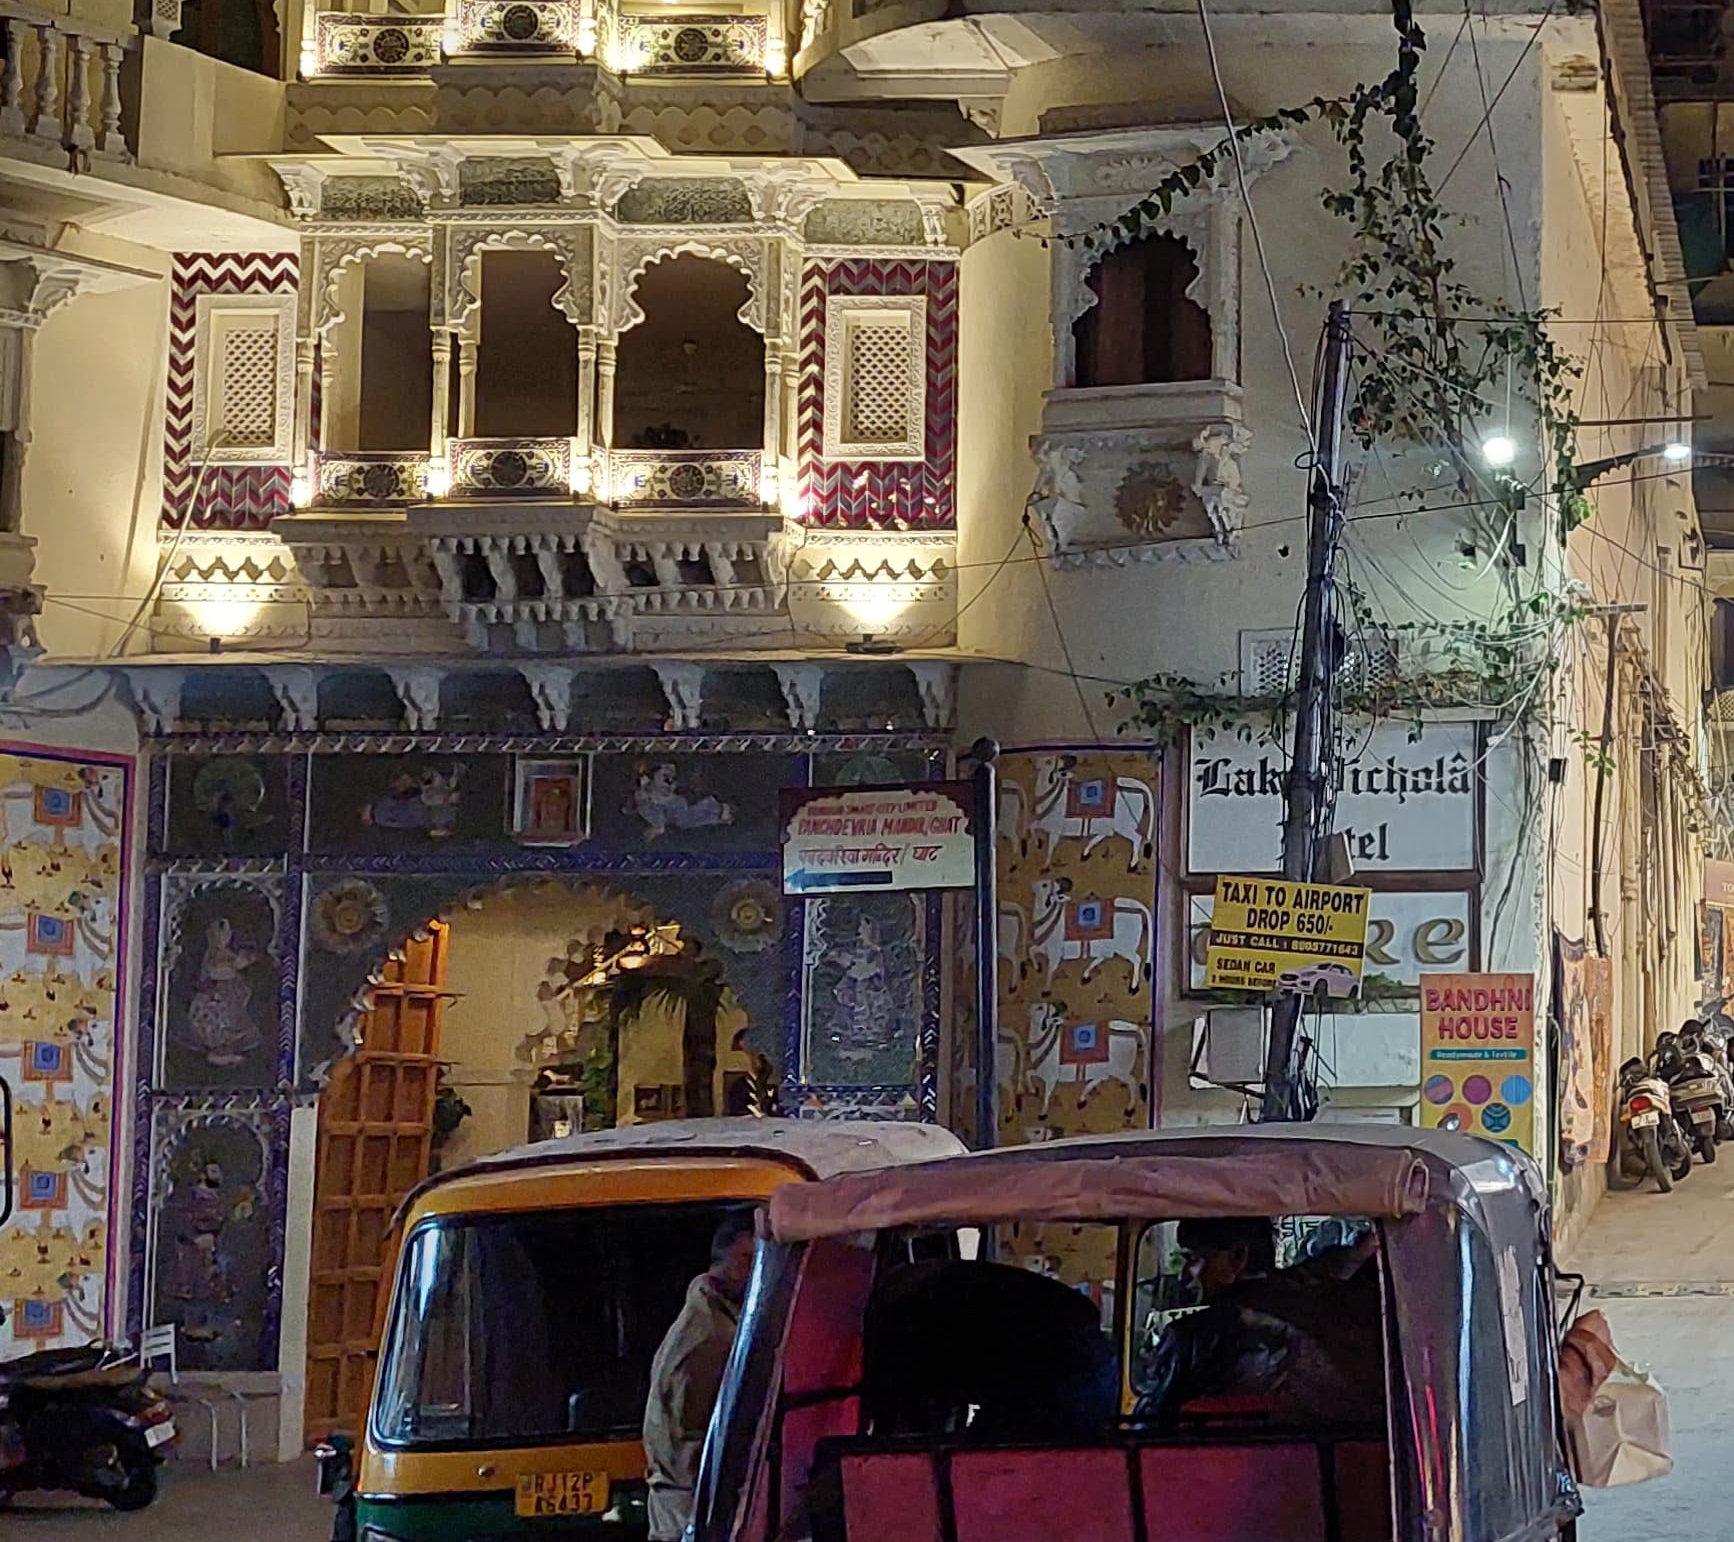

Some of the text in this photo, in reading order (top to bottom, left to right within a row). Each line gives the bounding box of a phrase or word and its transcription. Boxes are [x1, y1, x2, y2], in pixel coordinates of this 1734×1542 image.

[1195, 757, 1281, 797] Lak
[1222, 882, 1365, 915] TAXI TO AIRPORT
[1246, 909, 1333, 936] DROP 650/-
[1216, 934, 1245, 946] JUST
[1250, 936, 1280, 949] CALL
[1216, 958, 1276, 974] SEDAN CAR
[1425, 988, 1532, 1012] BANDHNI
[1438, 1016, 1518, 1040] HOUSE
